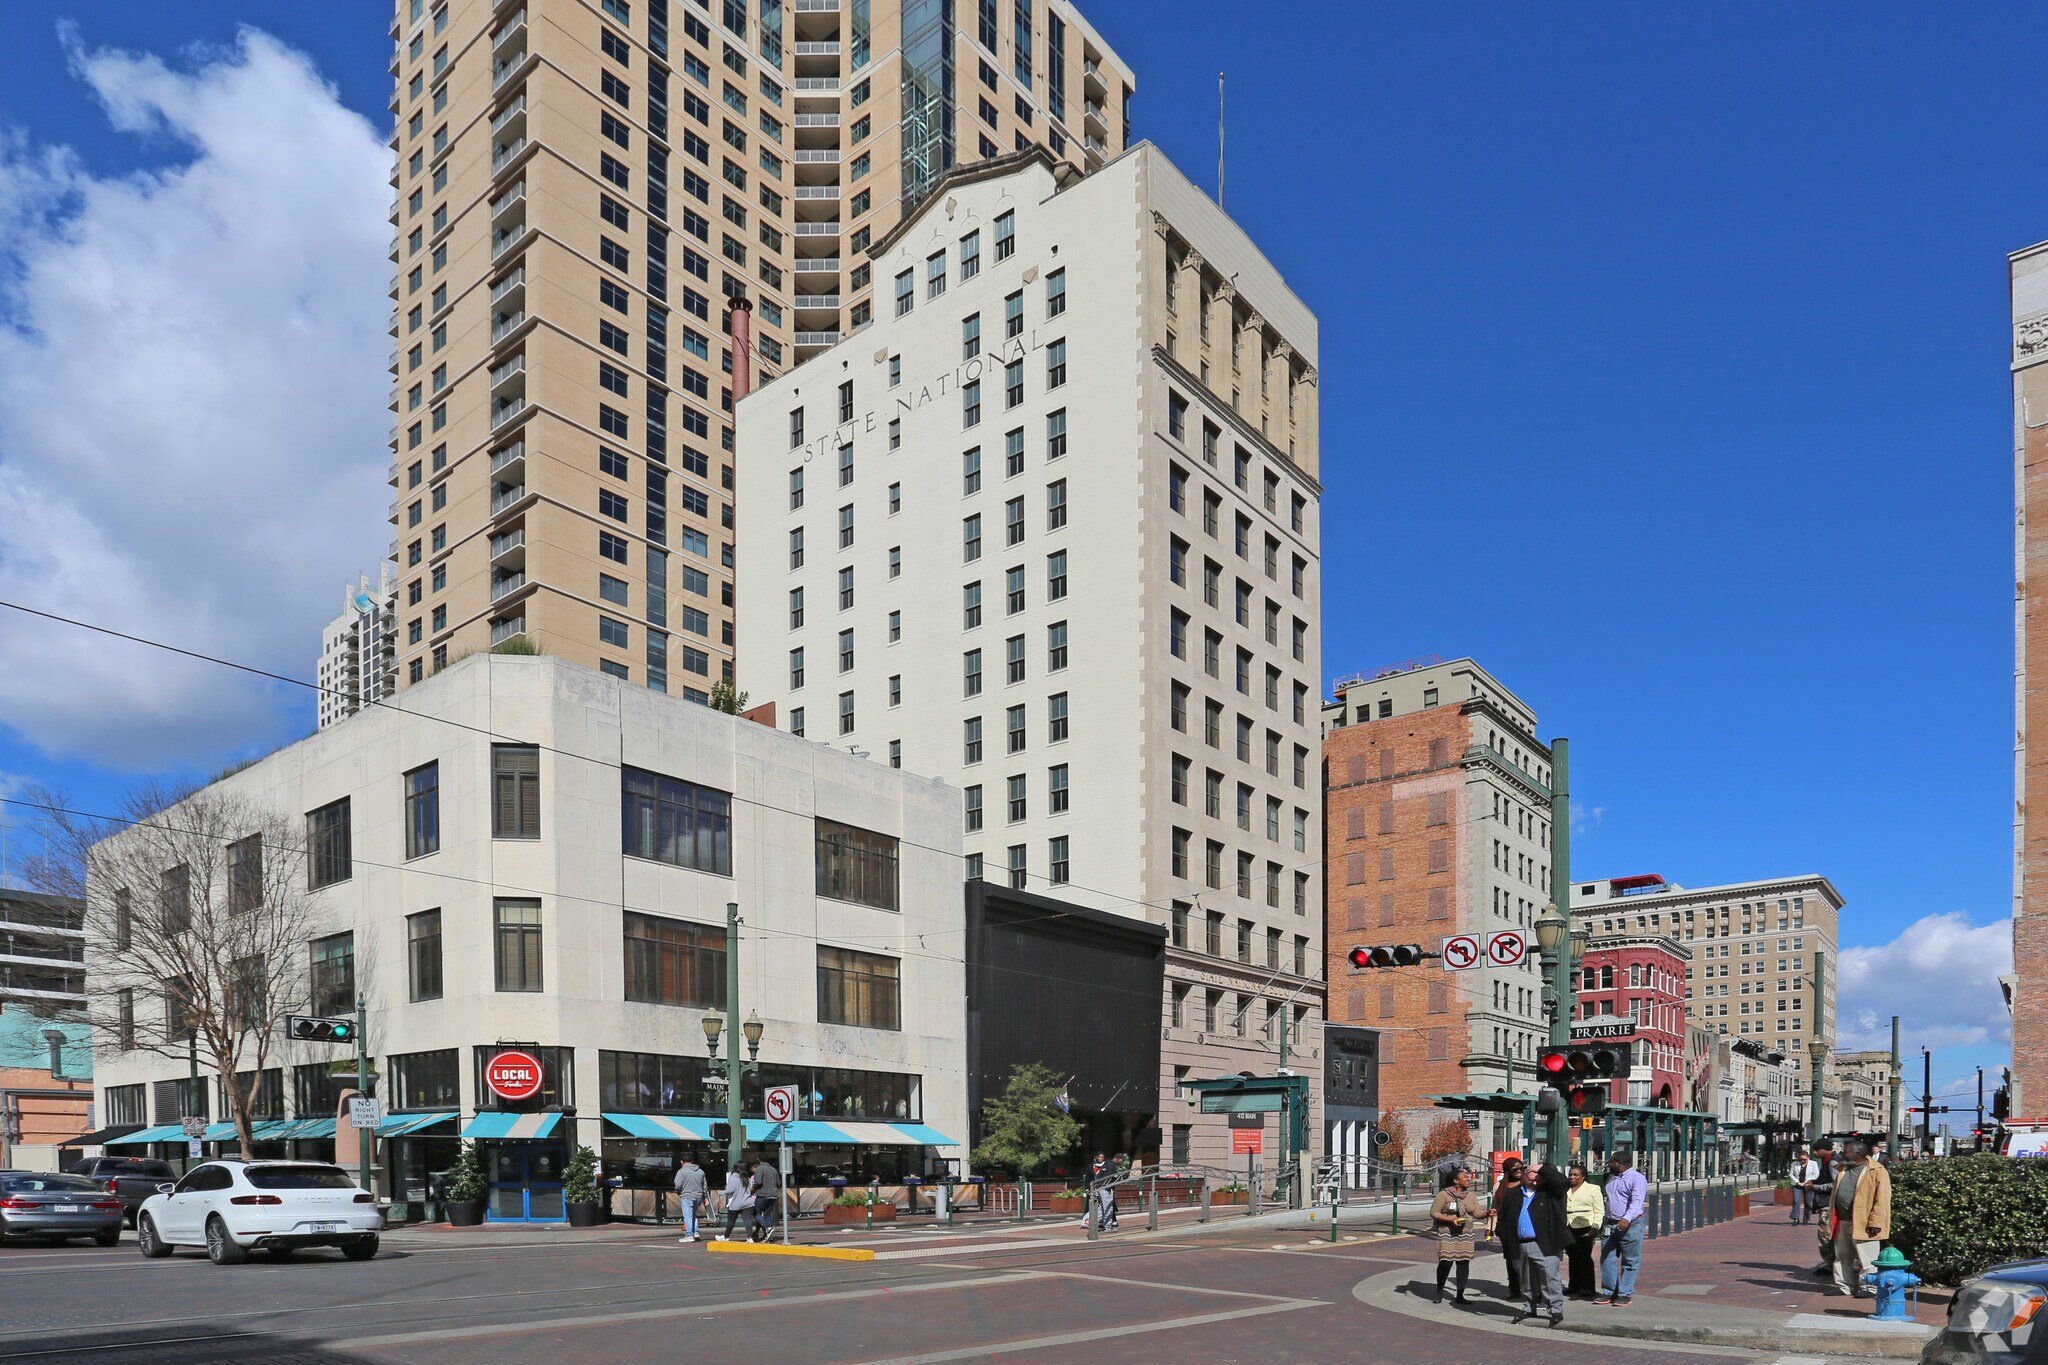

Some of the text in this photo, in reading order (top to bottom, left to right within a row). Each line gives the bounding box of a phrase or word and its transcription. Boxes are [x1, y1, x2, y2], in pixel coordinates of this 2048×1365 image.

[803, 329, 1045, 463] STATE NATIONAL
[1200, 971, 1223, 985] STATE
[1576, 1025, 1631, 1038] PRAIRIE
[493, 1069, 533, 1080] LOCAL
